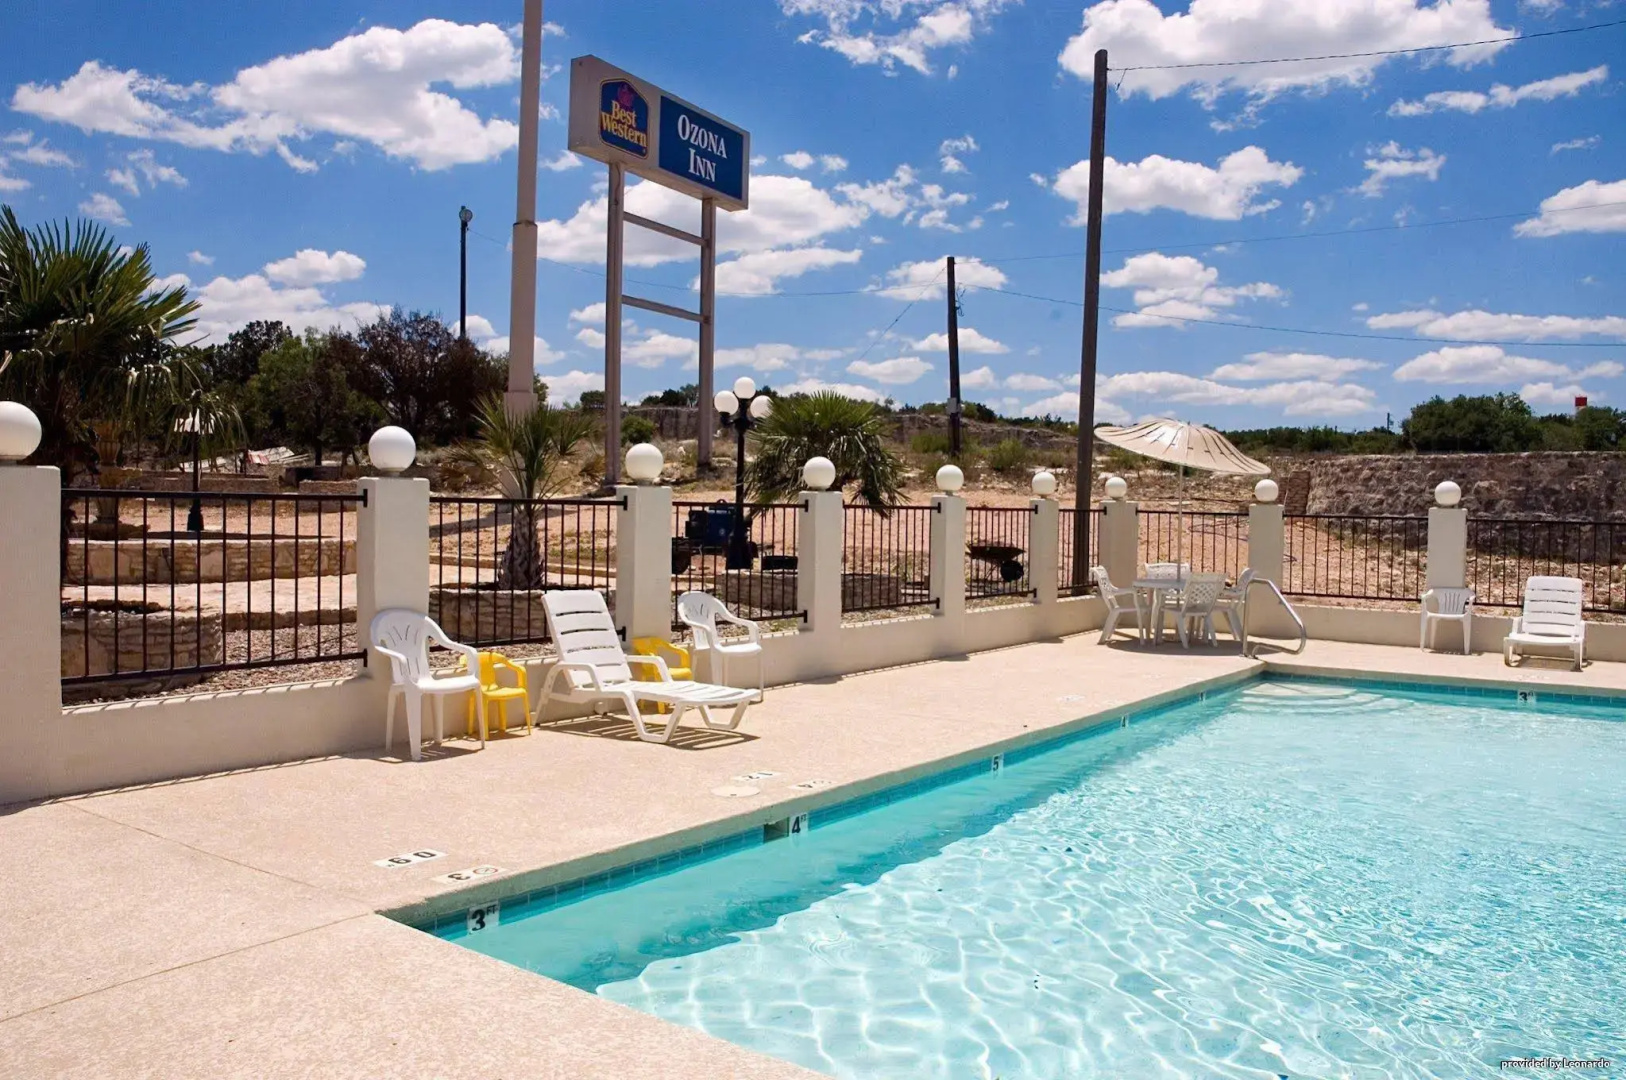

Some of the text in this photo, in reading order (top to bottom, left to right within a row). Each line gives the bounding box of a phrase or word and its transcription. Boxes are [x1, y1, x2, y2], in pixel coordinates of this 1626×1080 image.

[612, 100, 636, 127] Best
[601, 112, 646, 147] Western
[677, 114, 728, 159] OZONA
[688, 148, 716, 182] INN
[992, 755, 999, 771] 5
[792, 816, 801, 833] 4
[471, 909, 486, 931] 3
